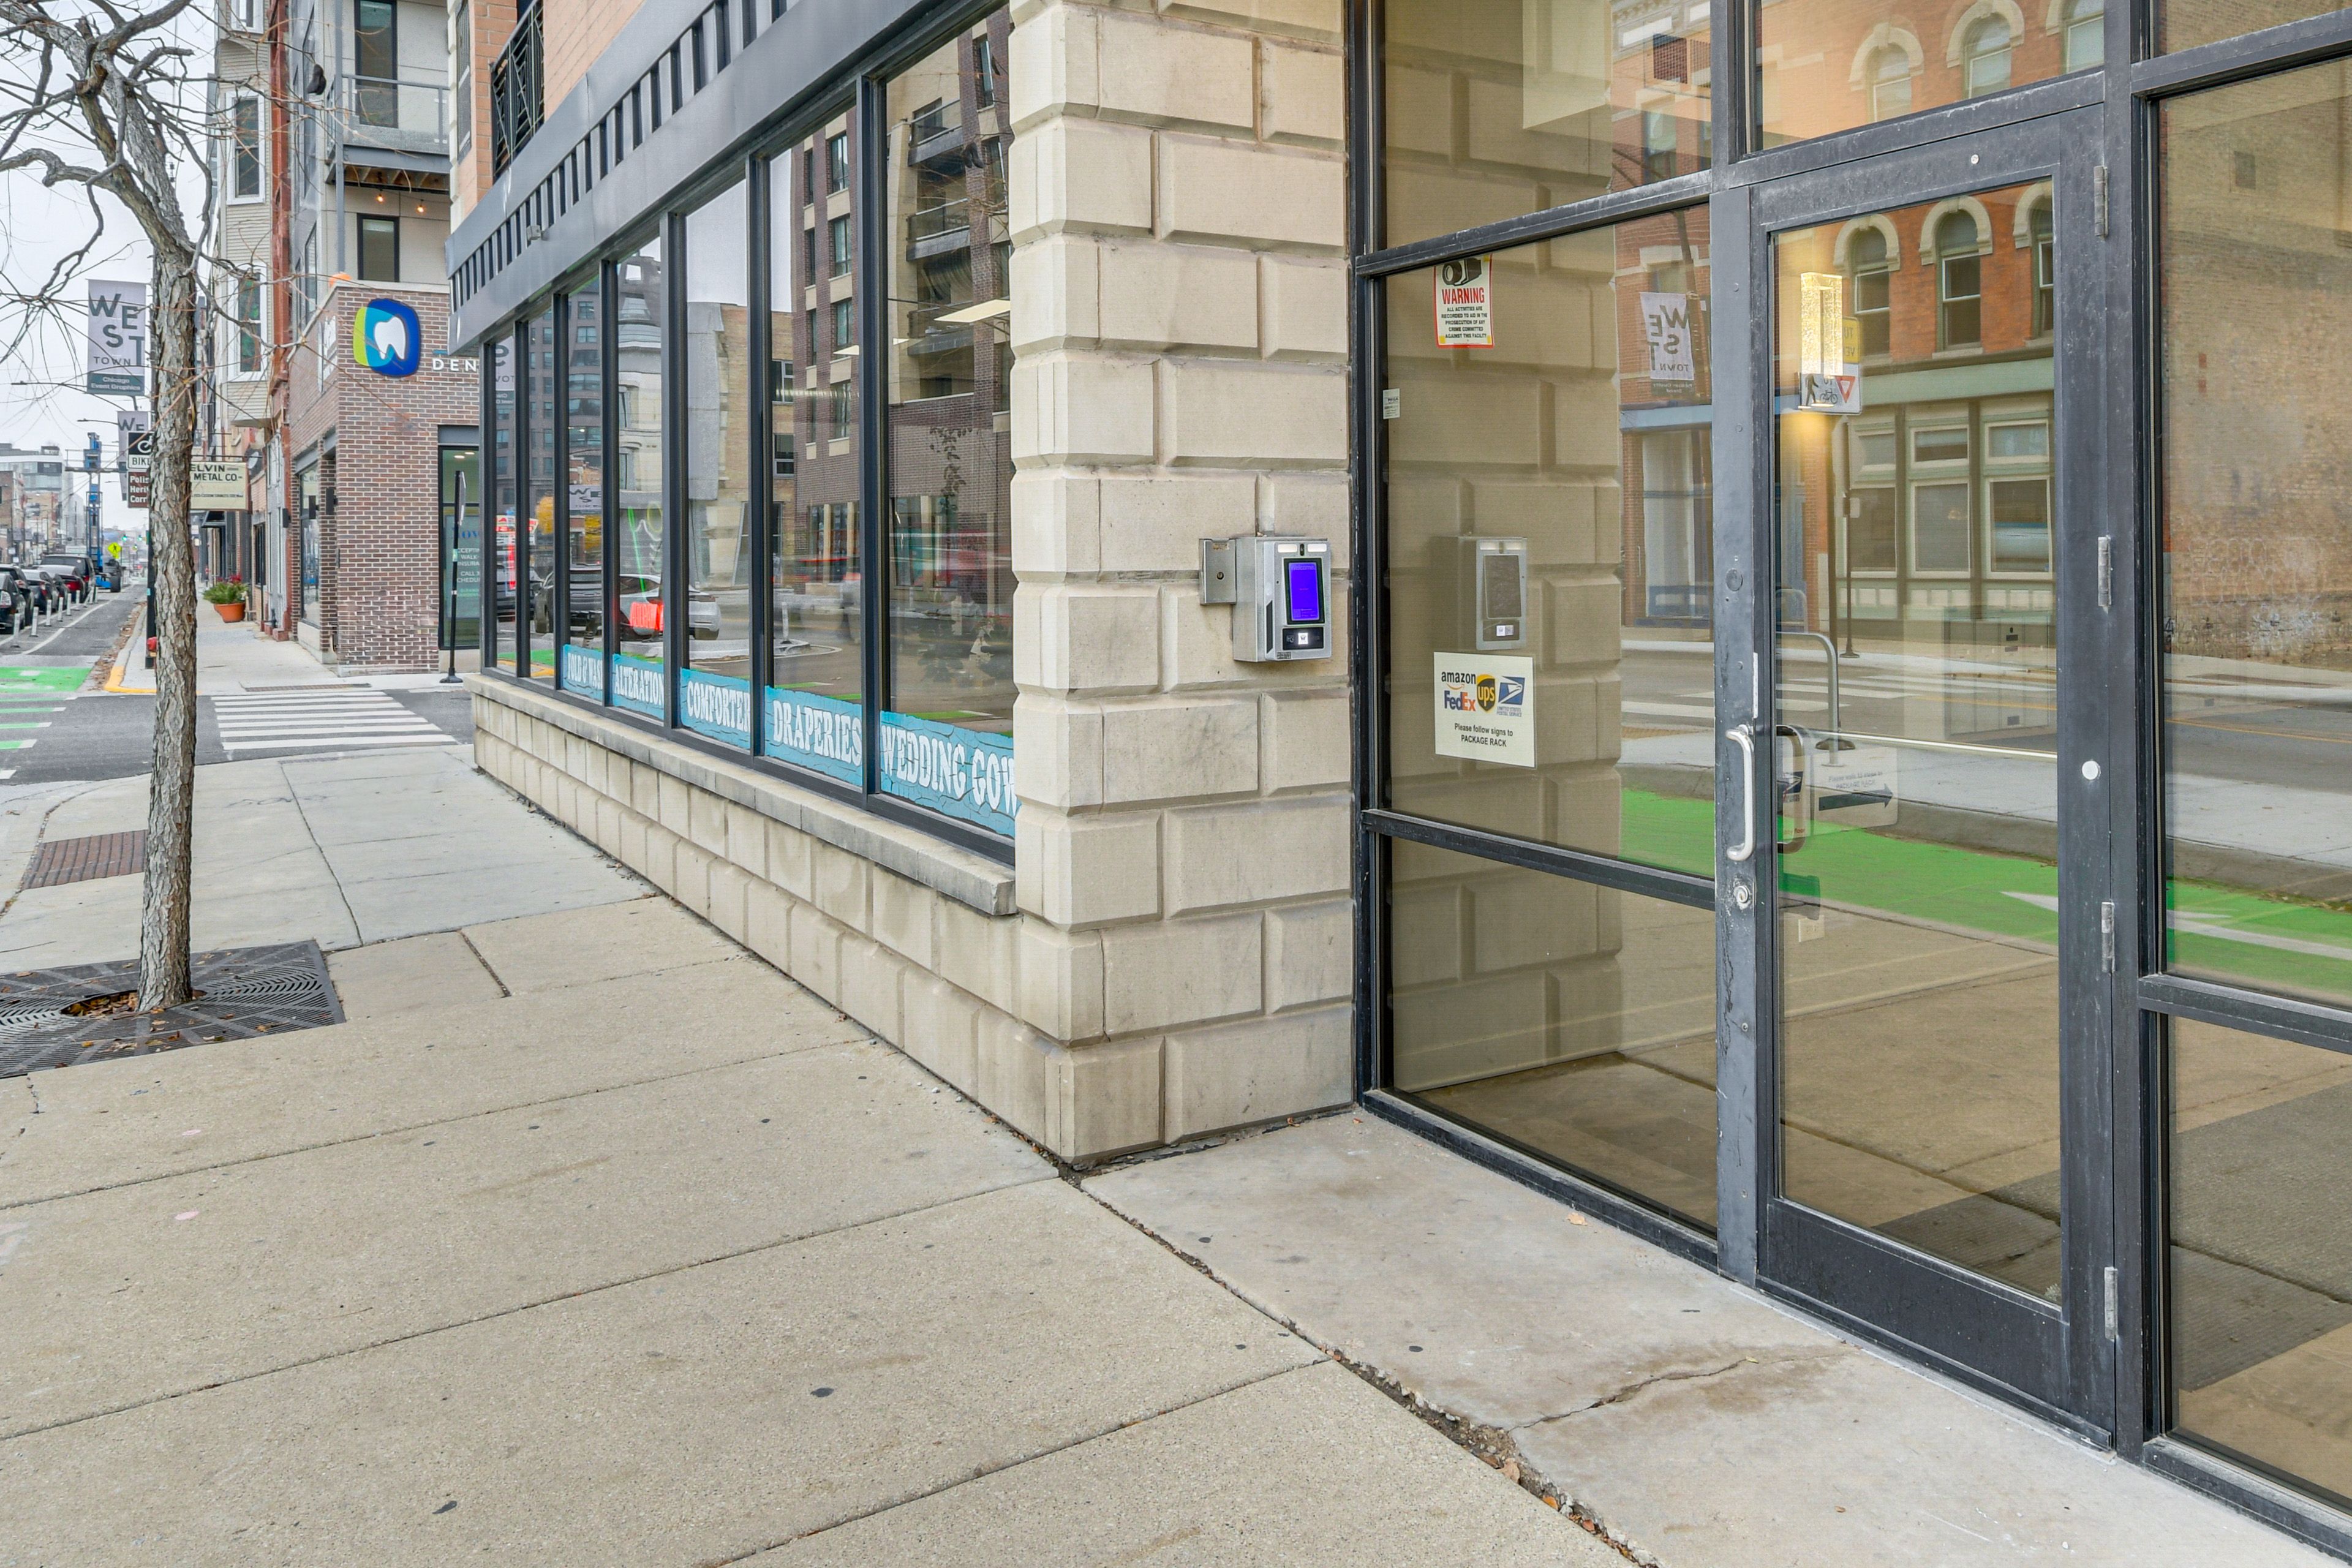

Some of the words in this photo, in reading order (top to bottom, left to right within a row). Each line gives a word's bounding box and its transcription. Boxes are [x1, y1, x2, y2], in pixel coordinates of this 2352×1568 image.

[1442, 287, 1485, 304] WARNING
[93, 356, 131, 366] TOWN
[432, 358, 477, 372] DEN
[1441, 671, 1476, 685] amazon
[1444, 690, 1476, 712] FedEx
[1478, 687, 1494, 707] ups
[773, 700, 862, 766] DRAPERIES
[1454, 723, 1472, 732] Please
[1473, 725, 1490, 734] follow
[1491, 727, 1506, 737] signs
[1461, 734, 1488, 745] PACKAGE
[1490, 738, 1507, 747] RACK
[881, 725, 966, 799] WEDDING
